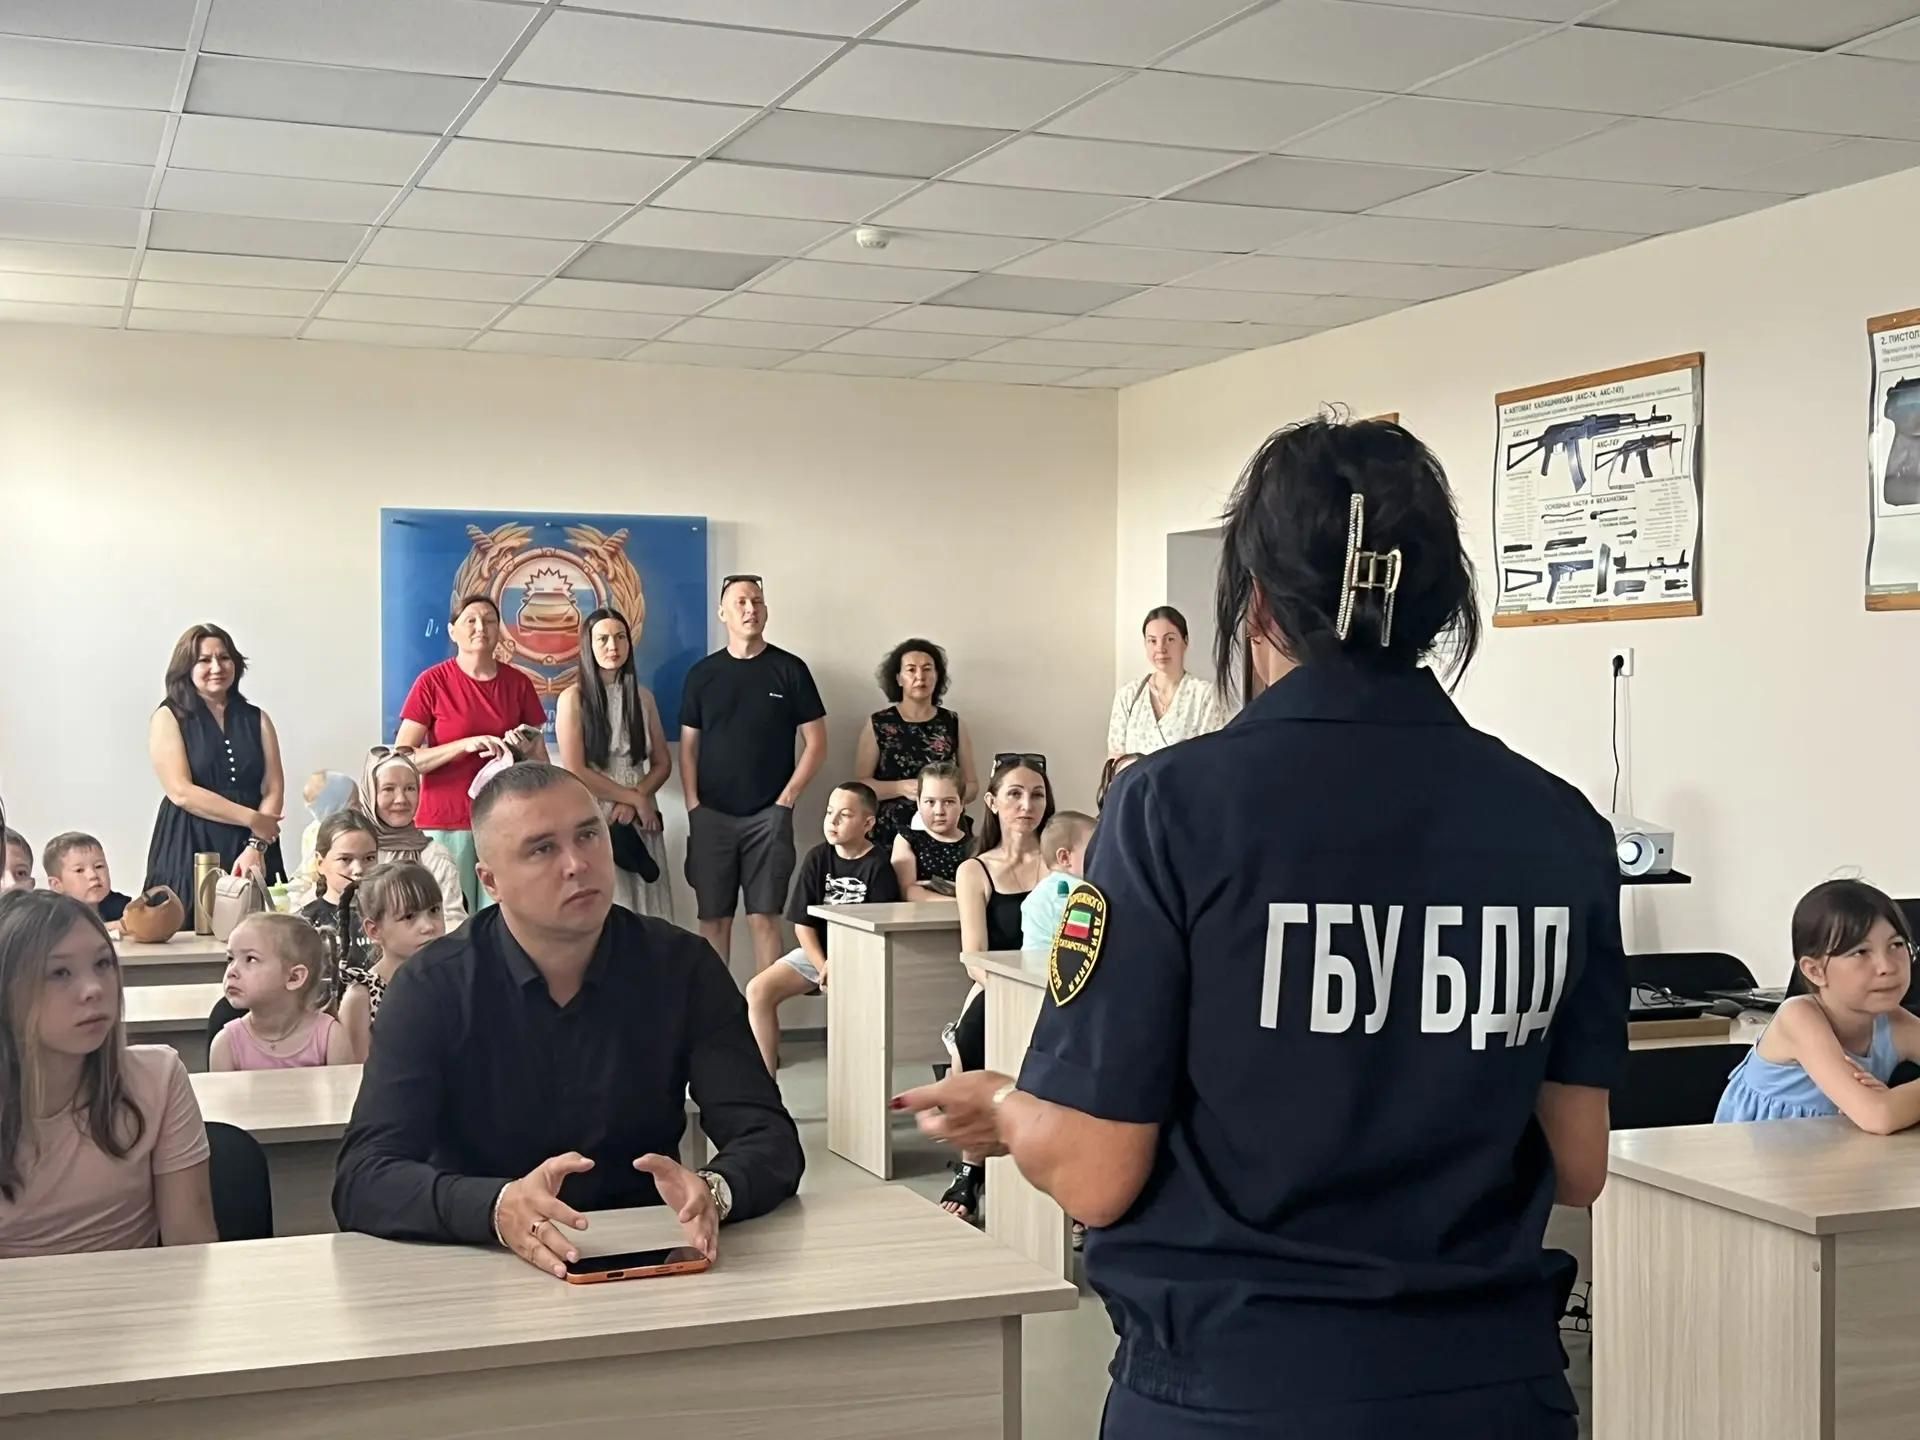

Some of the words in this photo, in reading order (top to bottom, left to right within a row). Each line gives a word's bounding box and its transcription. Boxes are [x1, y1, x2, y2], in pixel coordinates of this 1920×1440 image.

[1881, 336, 1888, 345] 2.
[1513, 429, 1529, 438] АКС-74
[1059, 939, 1089, 954] ТАТАРСТАН
[1260, 903, 1404, 1035] ГБУ
[1420, 905, 1570, 1050] БДД
